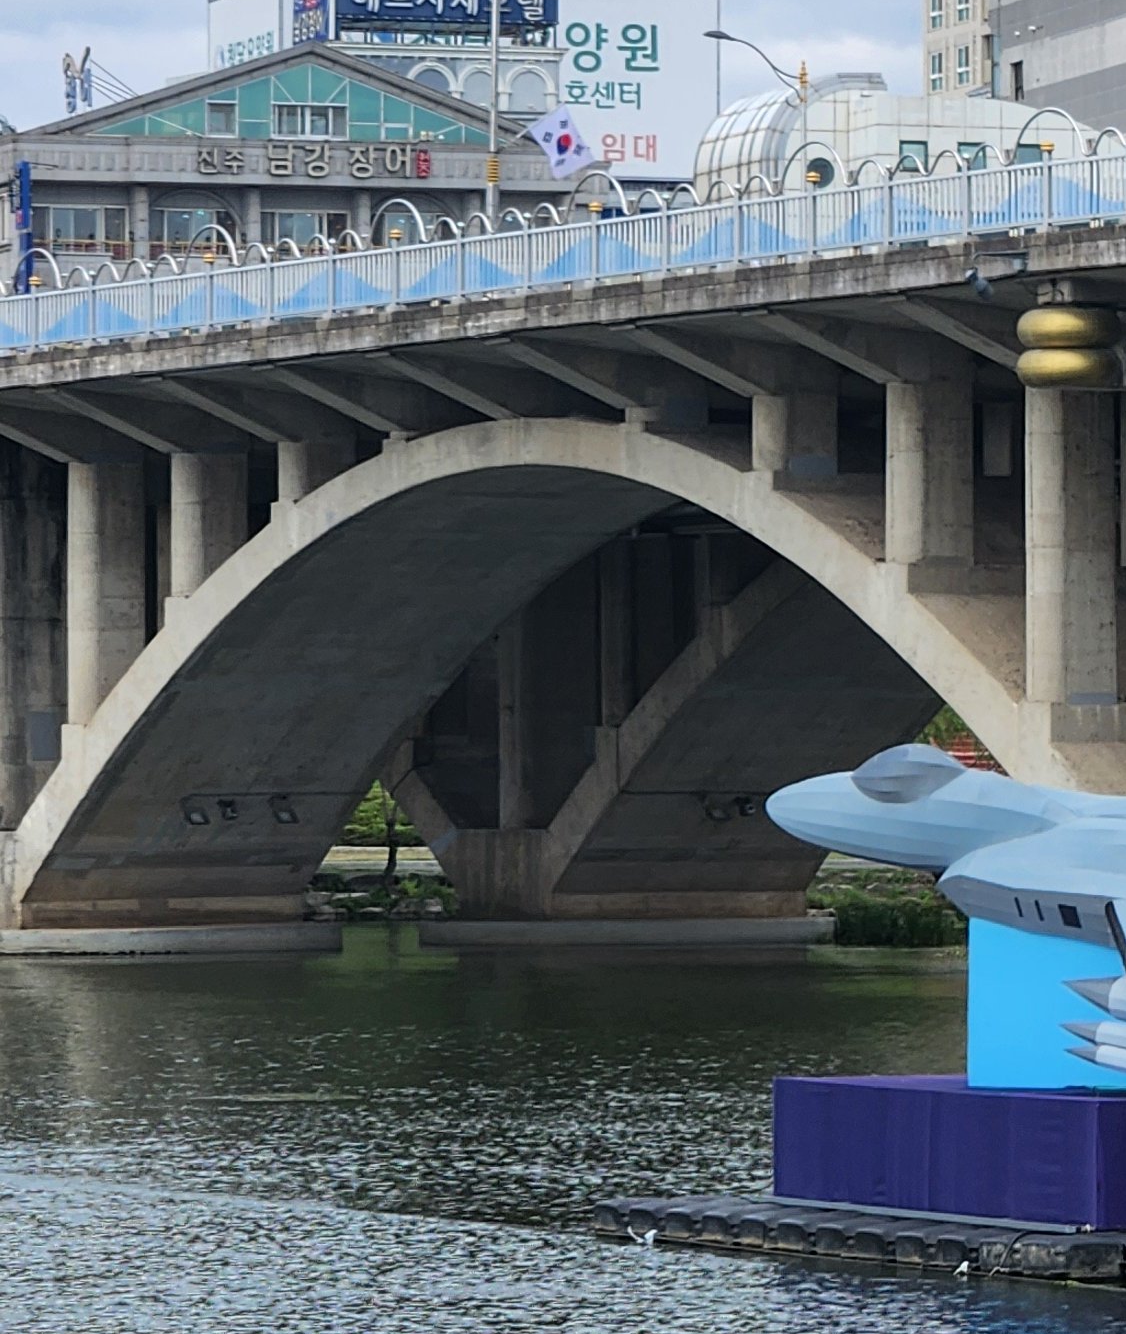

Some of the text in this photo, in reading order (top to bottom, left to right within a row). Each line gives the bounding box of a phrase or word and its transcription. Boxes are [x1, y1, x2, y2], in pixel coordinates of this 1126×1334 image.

[564, 80, 642, 110] 호센터
[198, 147, 245, 175] 진주
[601, 133, 657, 163] 임대
